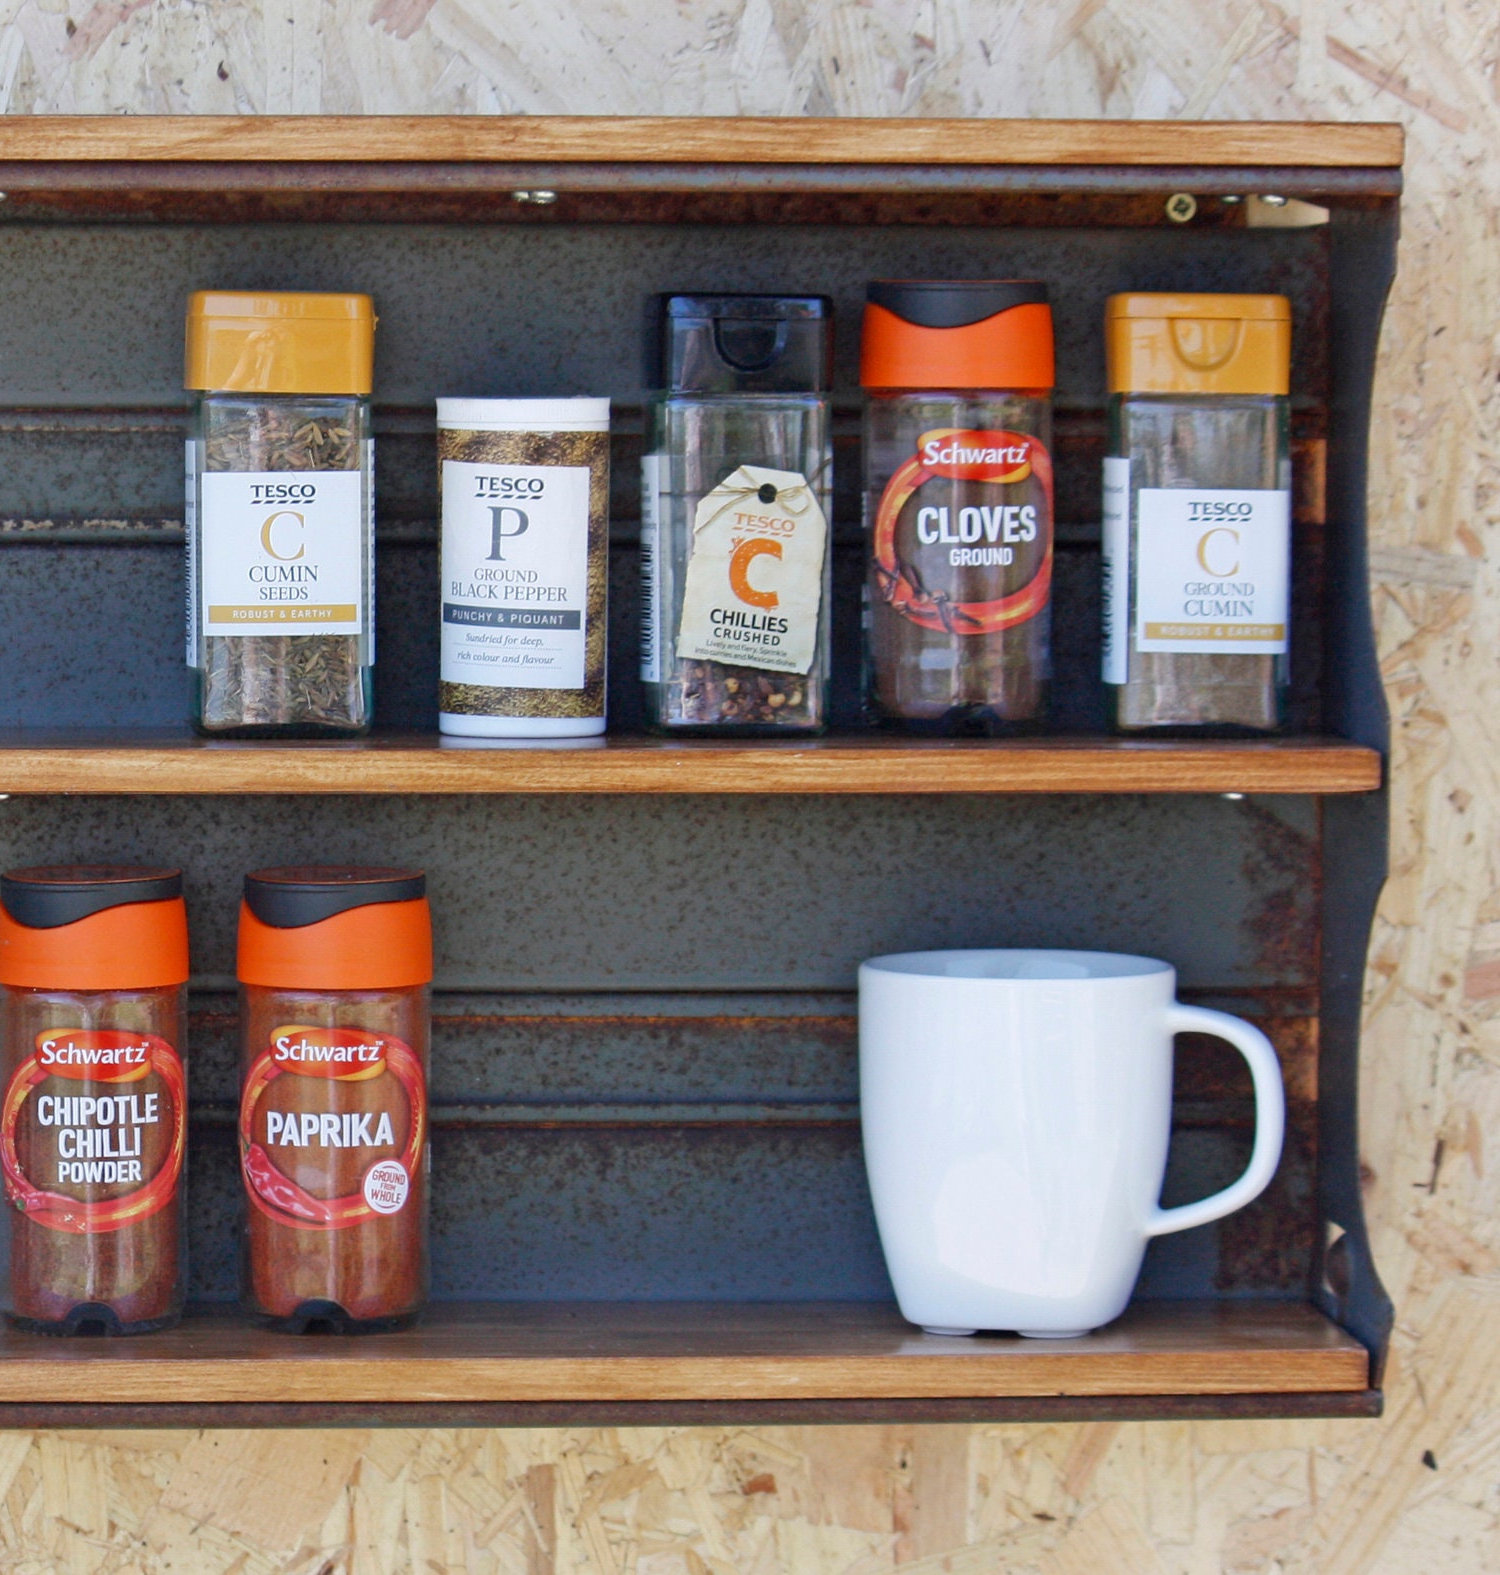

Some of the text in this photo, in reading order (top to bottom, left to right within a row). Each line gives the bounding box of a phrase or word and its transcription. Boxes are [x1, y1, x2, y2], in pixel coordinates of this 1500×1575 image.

[923, 441, 1028, 465] Schwartz
[250, 484, 316, 498] TESCO
[474, 476, 544, 494] TESCO
[1188, 502, 1253, 516] TESCO
[734, 512, 796, 533] TESCO
[917, 505, 1037, 545] CLOVES
[260, 511, 305, 561] C
[485, 505, 529, 561] P
[949, 547, 1013, 567] GROUND
[1196, 528, 1240, 578] C
[248, 565, 318, 583] CUMIN
[474, 567, 538, 583] GROUND
[728, 538, 783, 610] C
[259, 586, 308, 601] SEEDS
[451, 581, 568, 601] BLACK PEPPER
[1184, 582, 1255, 596] GROUND
[232, 609, 332, 619] ROBUST & EARTHY
[452, 609, 564, 625] PUNCHY & PIQUANT
[1184, 600, 1254, 617] CUMIN
[710, 608, 788, 634] CHILLIES
[465, 632, 502, 644] Sundried
[504, 635, 518, 648] for
[714, 627, 781, 646] CRUSHED
[1160, 626, 1210, 636] ROBUST
[1227, 627, 1276, 637] EARTHY
[457, 650, 555, 666] rich colour and flavour
[40, 1040, 146, 1065] Schwartz
[275, 1036, 380, 1062] Schwartz
[37, 1093, 159, 1126] CHIPOTLE
[267, 1111, 394, 1148] PAPRIKA
[58, 1127, 141, 1158] CHILLI
[58, 1160, 142, 1184] POWDER
[372, 1169, 406, 1185] GROUND
[371, 1188, 402, 1204] WHOLE
[380, 1182, 396, 1191] FROM
